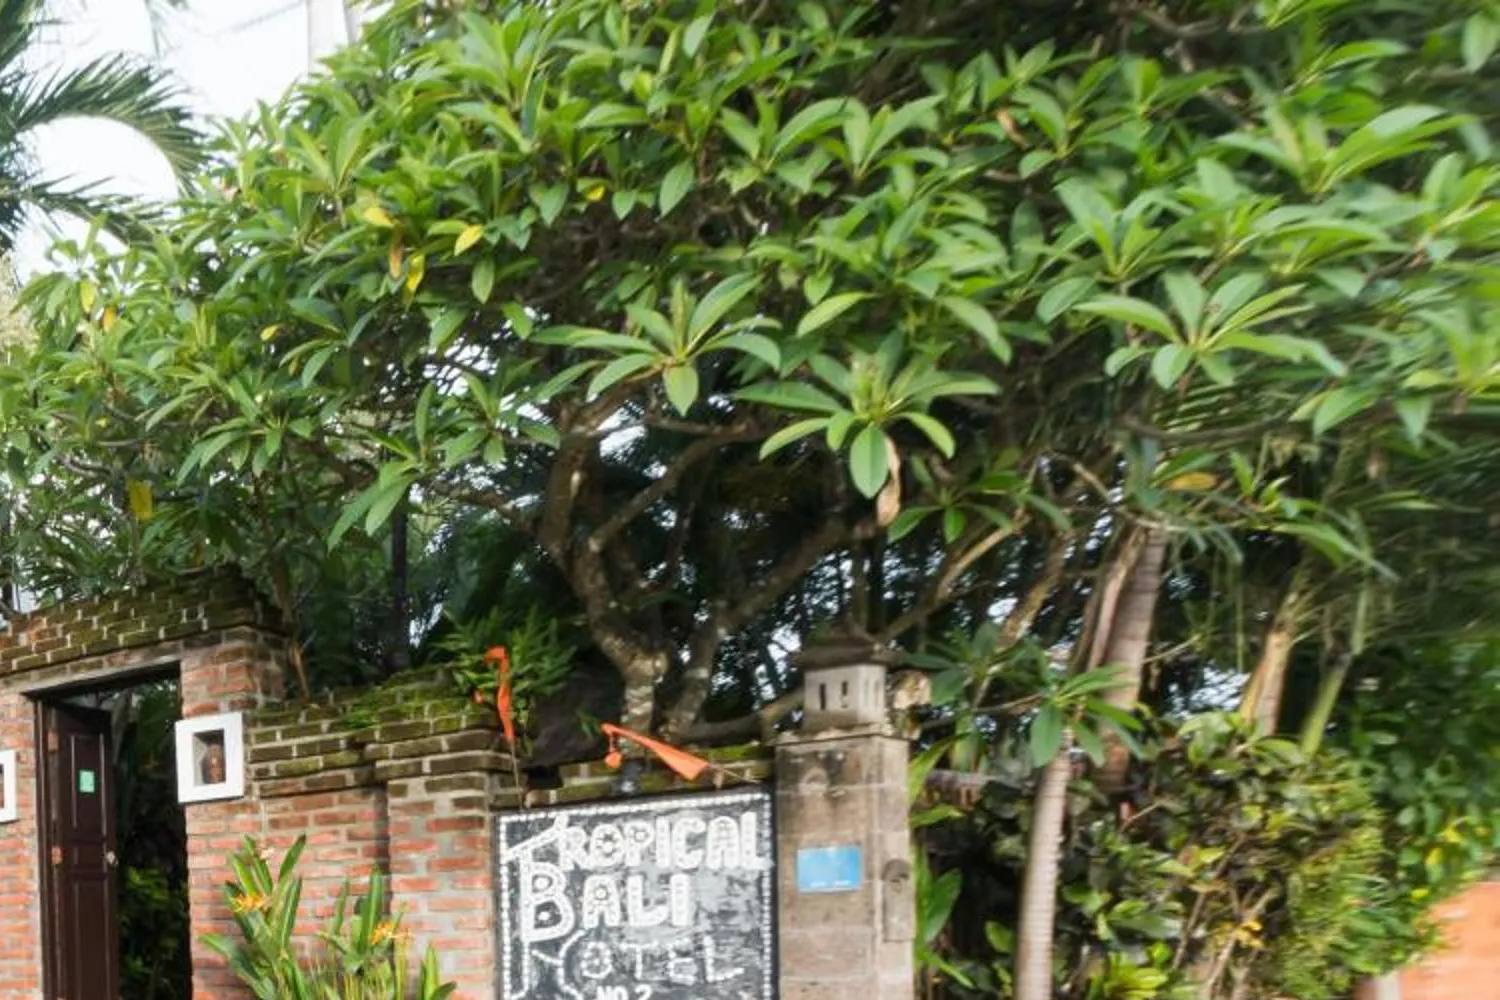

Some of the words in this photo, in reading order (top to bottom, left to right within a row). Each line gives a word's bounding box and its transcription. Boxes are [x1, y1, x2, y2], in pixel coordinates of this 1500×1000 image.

[501, 812, 770, 870] TROPICAL
[520, 861, 691, 942] BALI
[511, 931, 745, 1000] HOTEL
